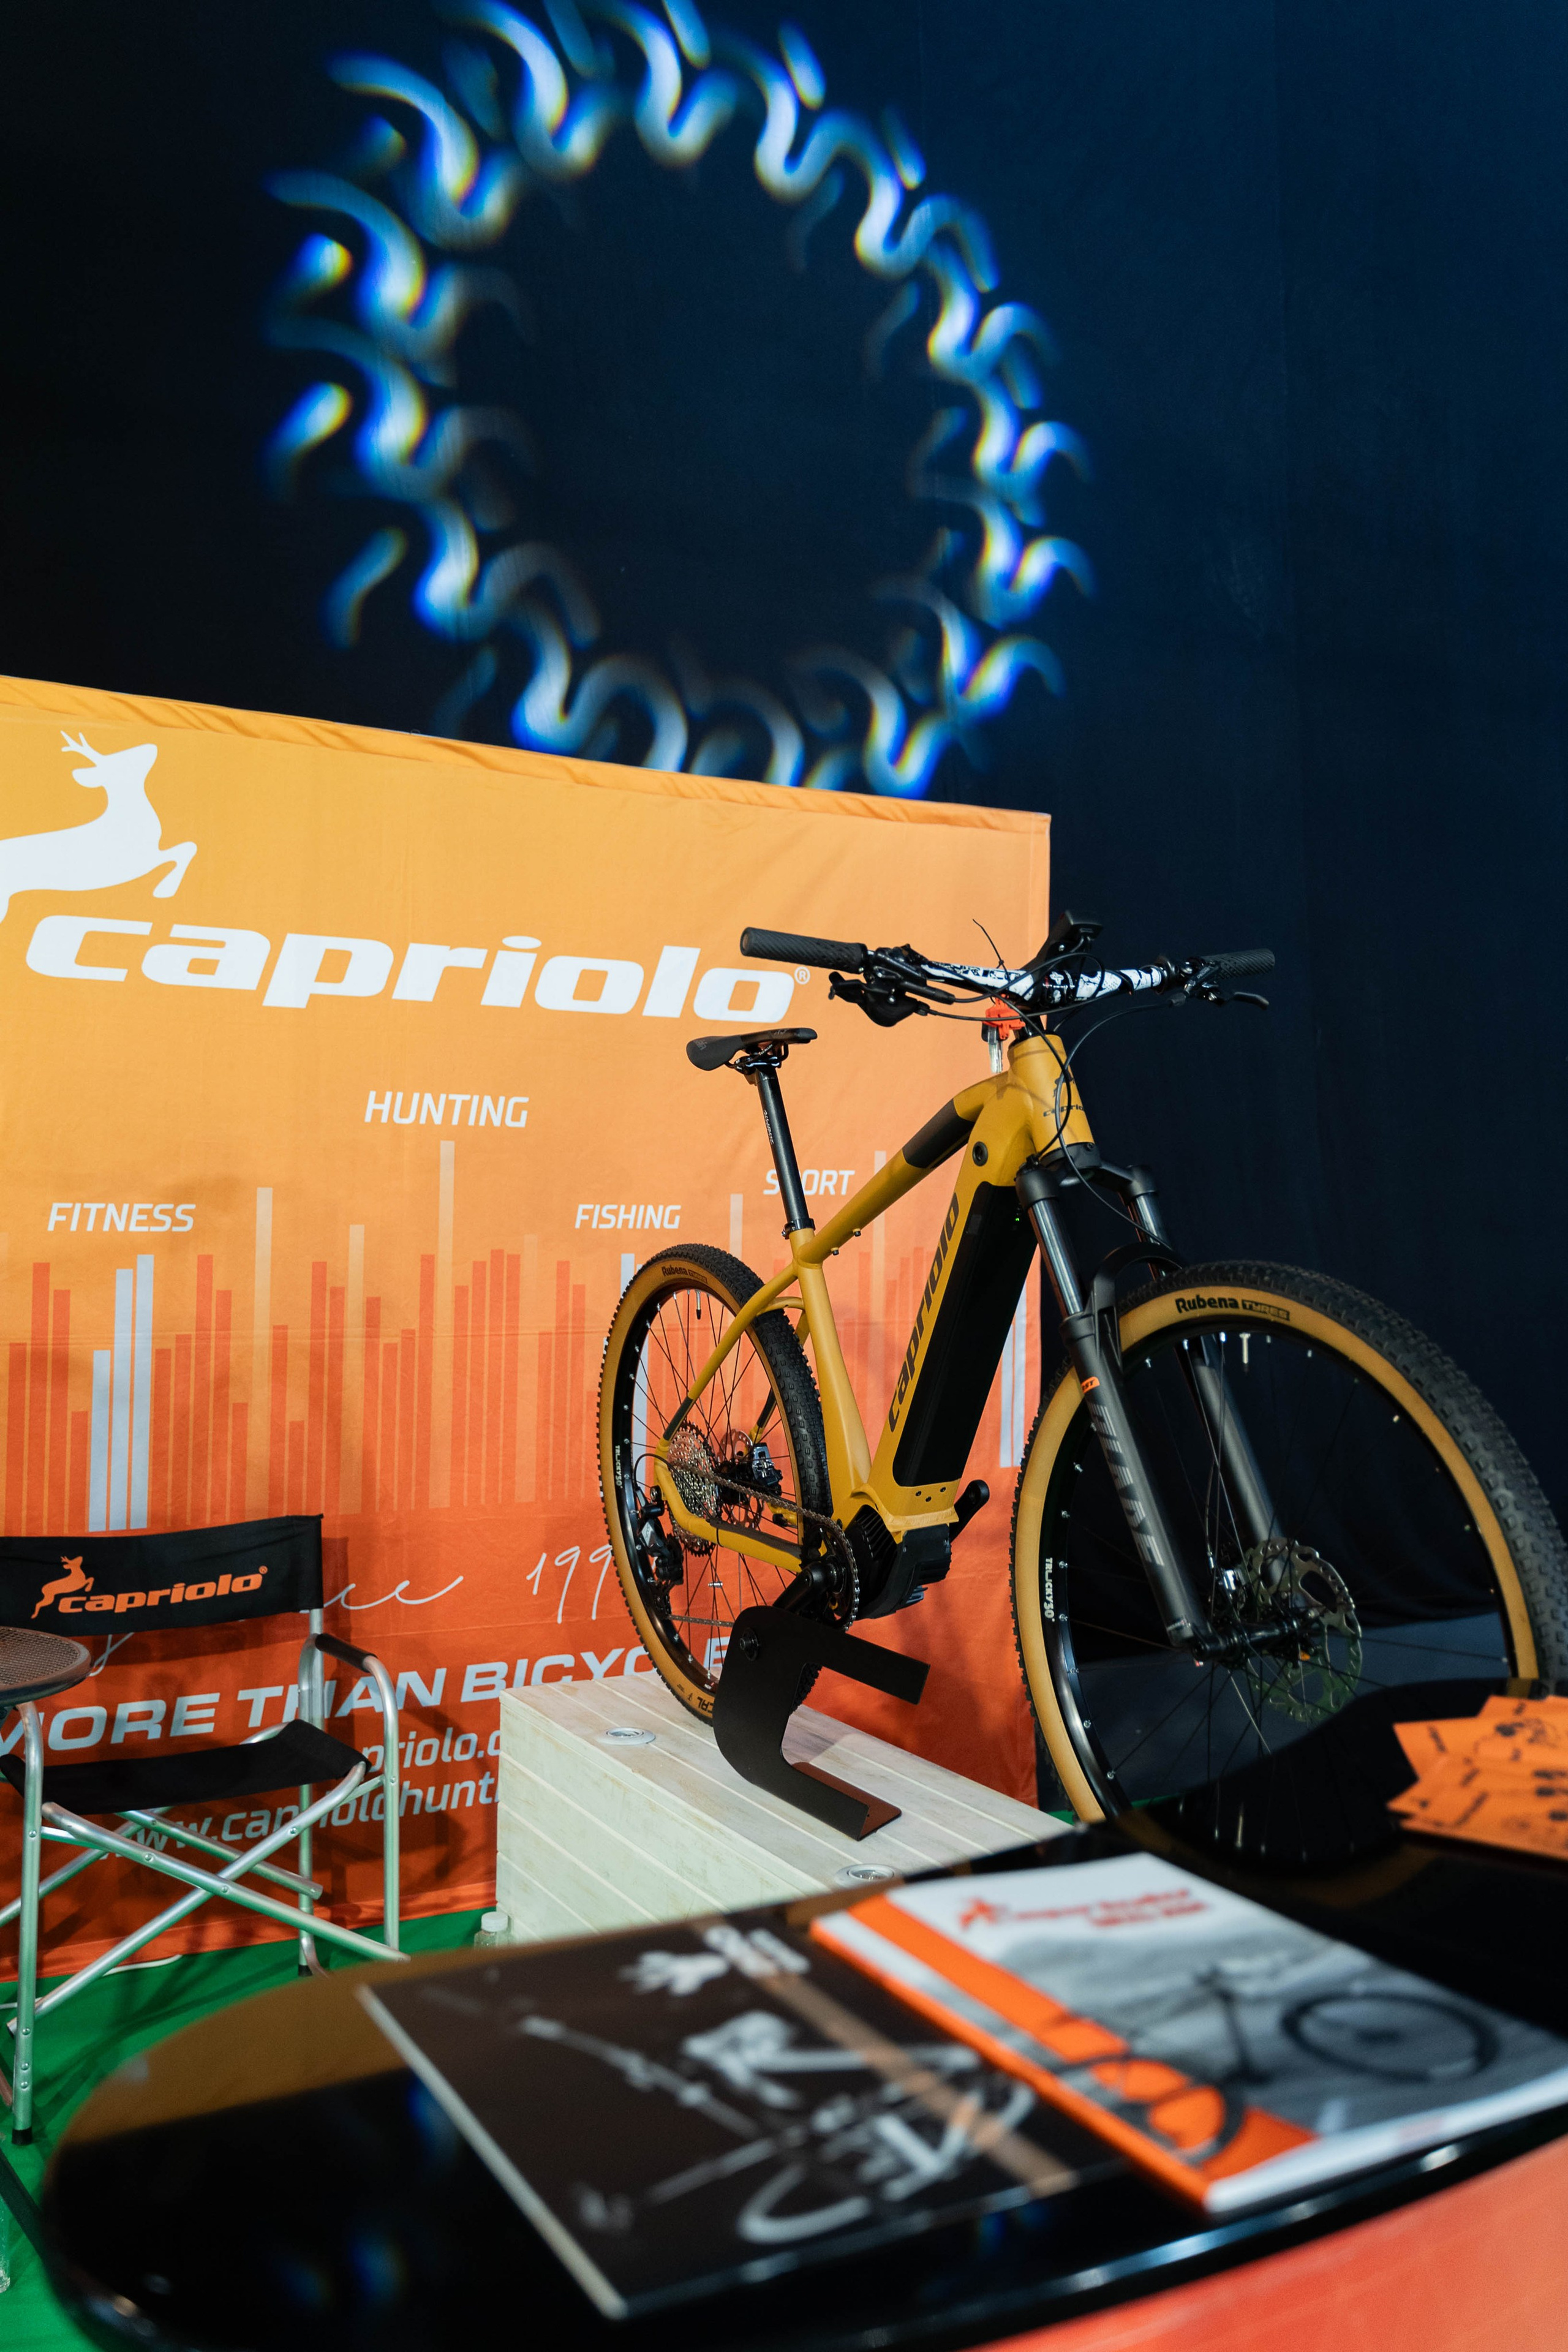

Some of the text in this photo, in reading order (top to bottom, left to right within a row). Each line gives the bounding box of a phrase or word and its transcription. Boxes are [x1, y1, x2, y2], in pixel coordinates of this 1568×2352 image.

[26, 914, 795, 1023] capriolo
[364, 1090, 529, 1128] HUNTING
[763, 1169, 855, 1196] SORT
[47, 1203, 196, 1232] FITNESS
[575, 1204, 681, 1229] FISHING
[662, 1264, 688, 1277] Rubena
[888, 1192, 960, 1433] capriolo
[1175, 1294, 1240, 1313] Rubena
[58, 1574, 263, 1613] capriolo
